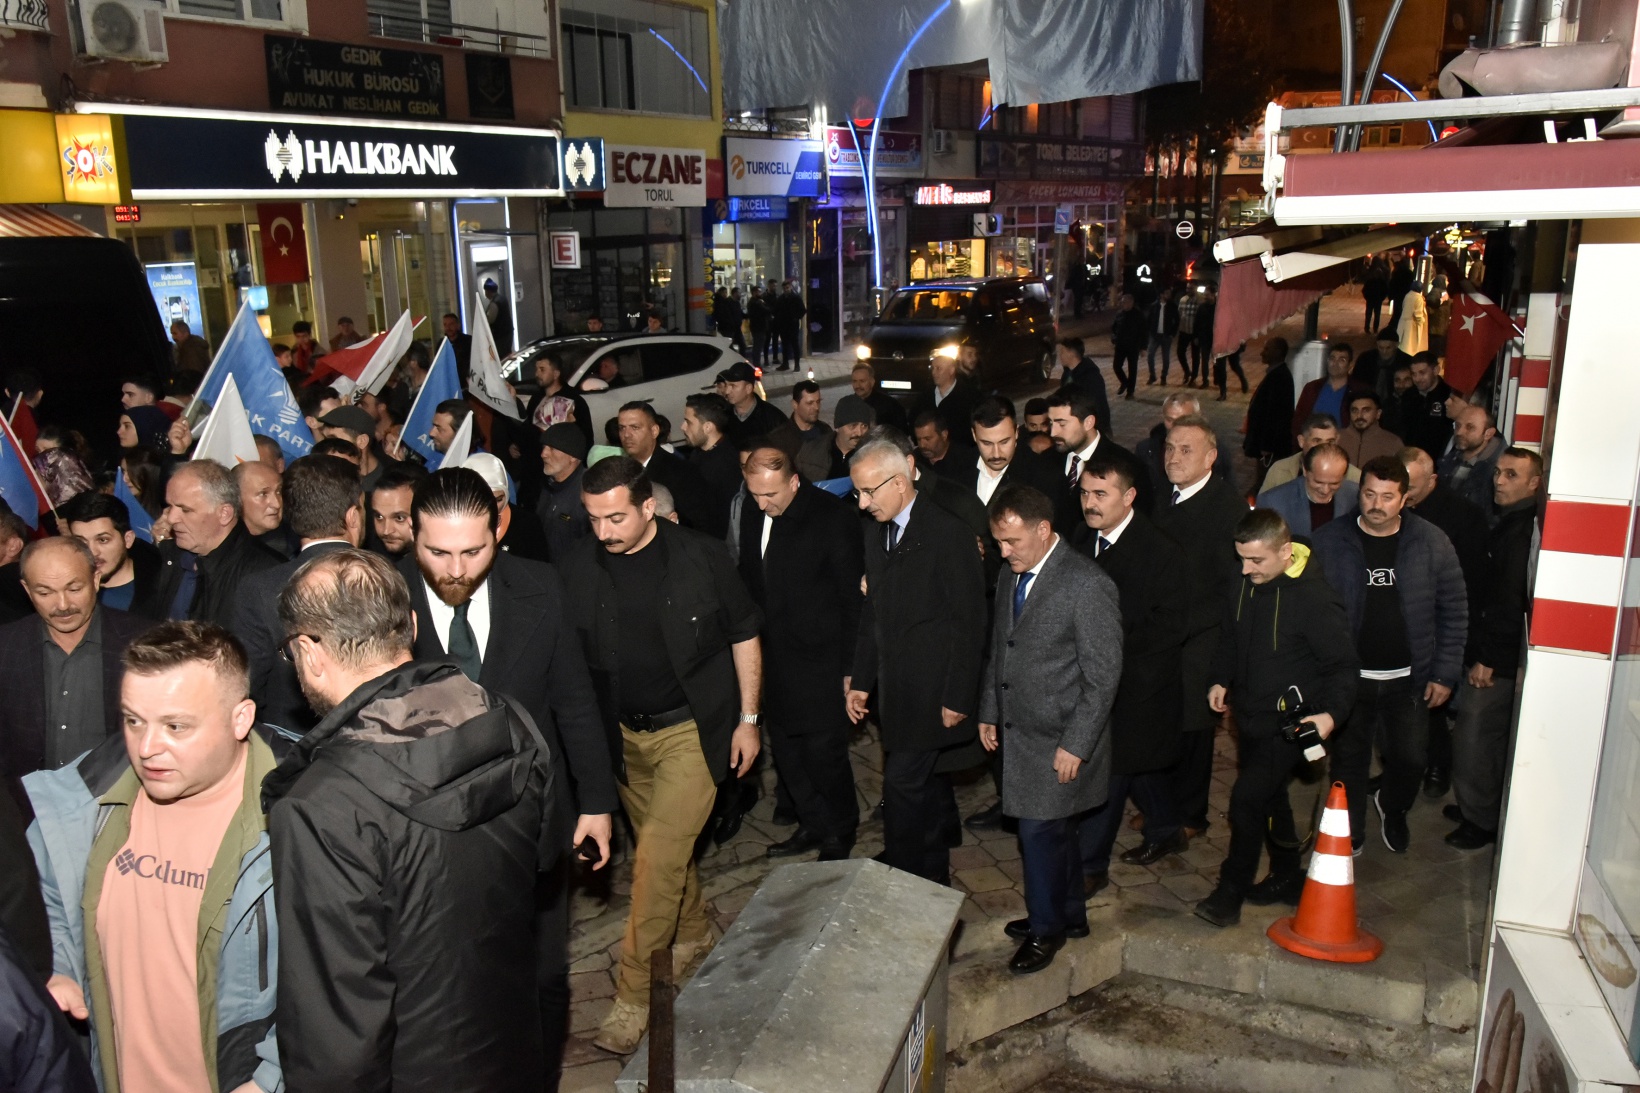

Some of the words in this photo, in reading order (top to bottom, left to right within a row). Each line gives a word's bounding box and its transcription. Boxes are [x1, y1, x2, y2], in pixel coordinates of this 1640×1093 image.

[341, 46, 383, 66] GEDİK
[303, 68, 355, 88] HUKUK
[364, 71, 419, 93] BÜROSU
[283, 92, 334, 109] AVUKAT
[343, 95, 402, 112] NESLİHAN
[407, 100, 440, 115] GEDİK
[63, 145, 113, 183] ŞOK
[305, 140, 457, 175] HALKBANK
[611, 151, 703, 184] ECZANE
[746, 161, 792, 174] TURKCELL
[645, 189, 674, 201] TORUL
[727, 197, 770, 210] TURKCELL
[557, 239, 573, 261] E
